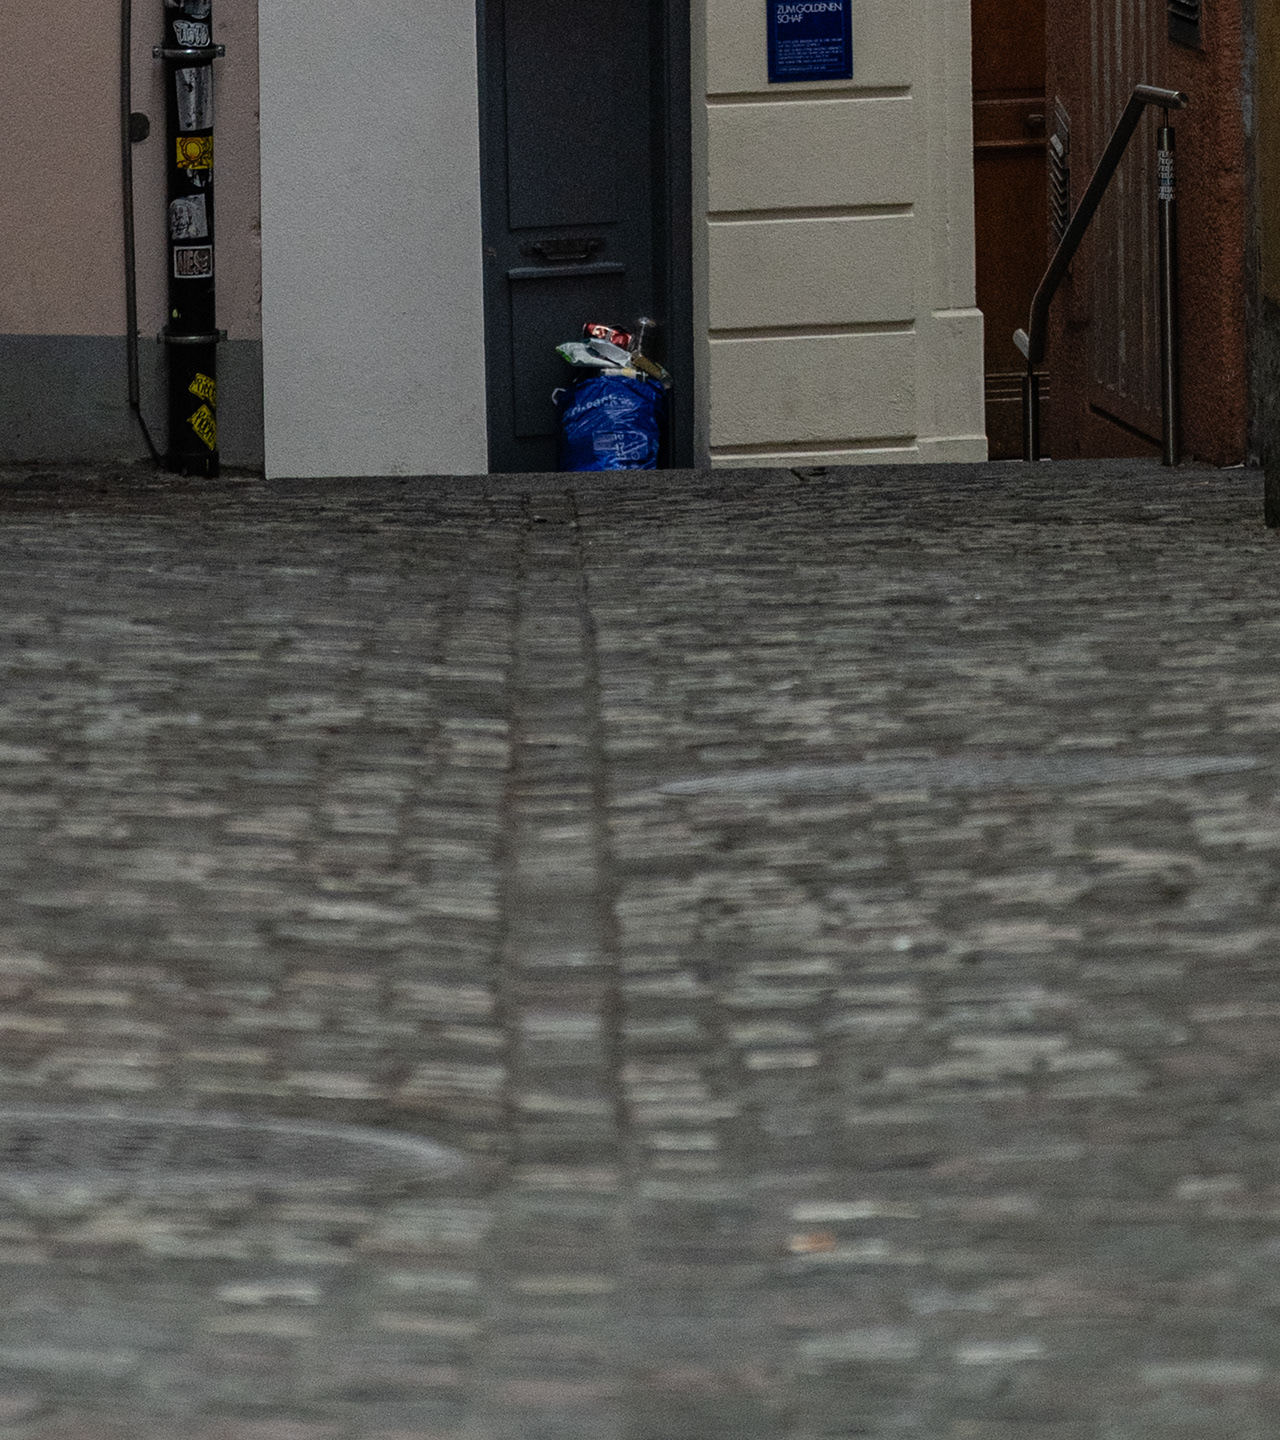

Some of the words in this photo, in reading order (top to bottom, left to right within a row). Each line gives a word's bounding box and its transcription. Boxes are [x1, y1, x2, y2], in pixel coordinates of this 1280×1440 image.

[777, 4, 796, 15] ZUM
[796, 2, 843, 13] GOLDENEN
[777, 14, 804, 24] SCHAF
